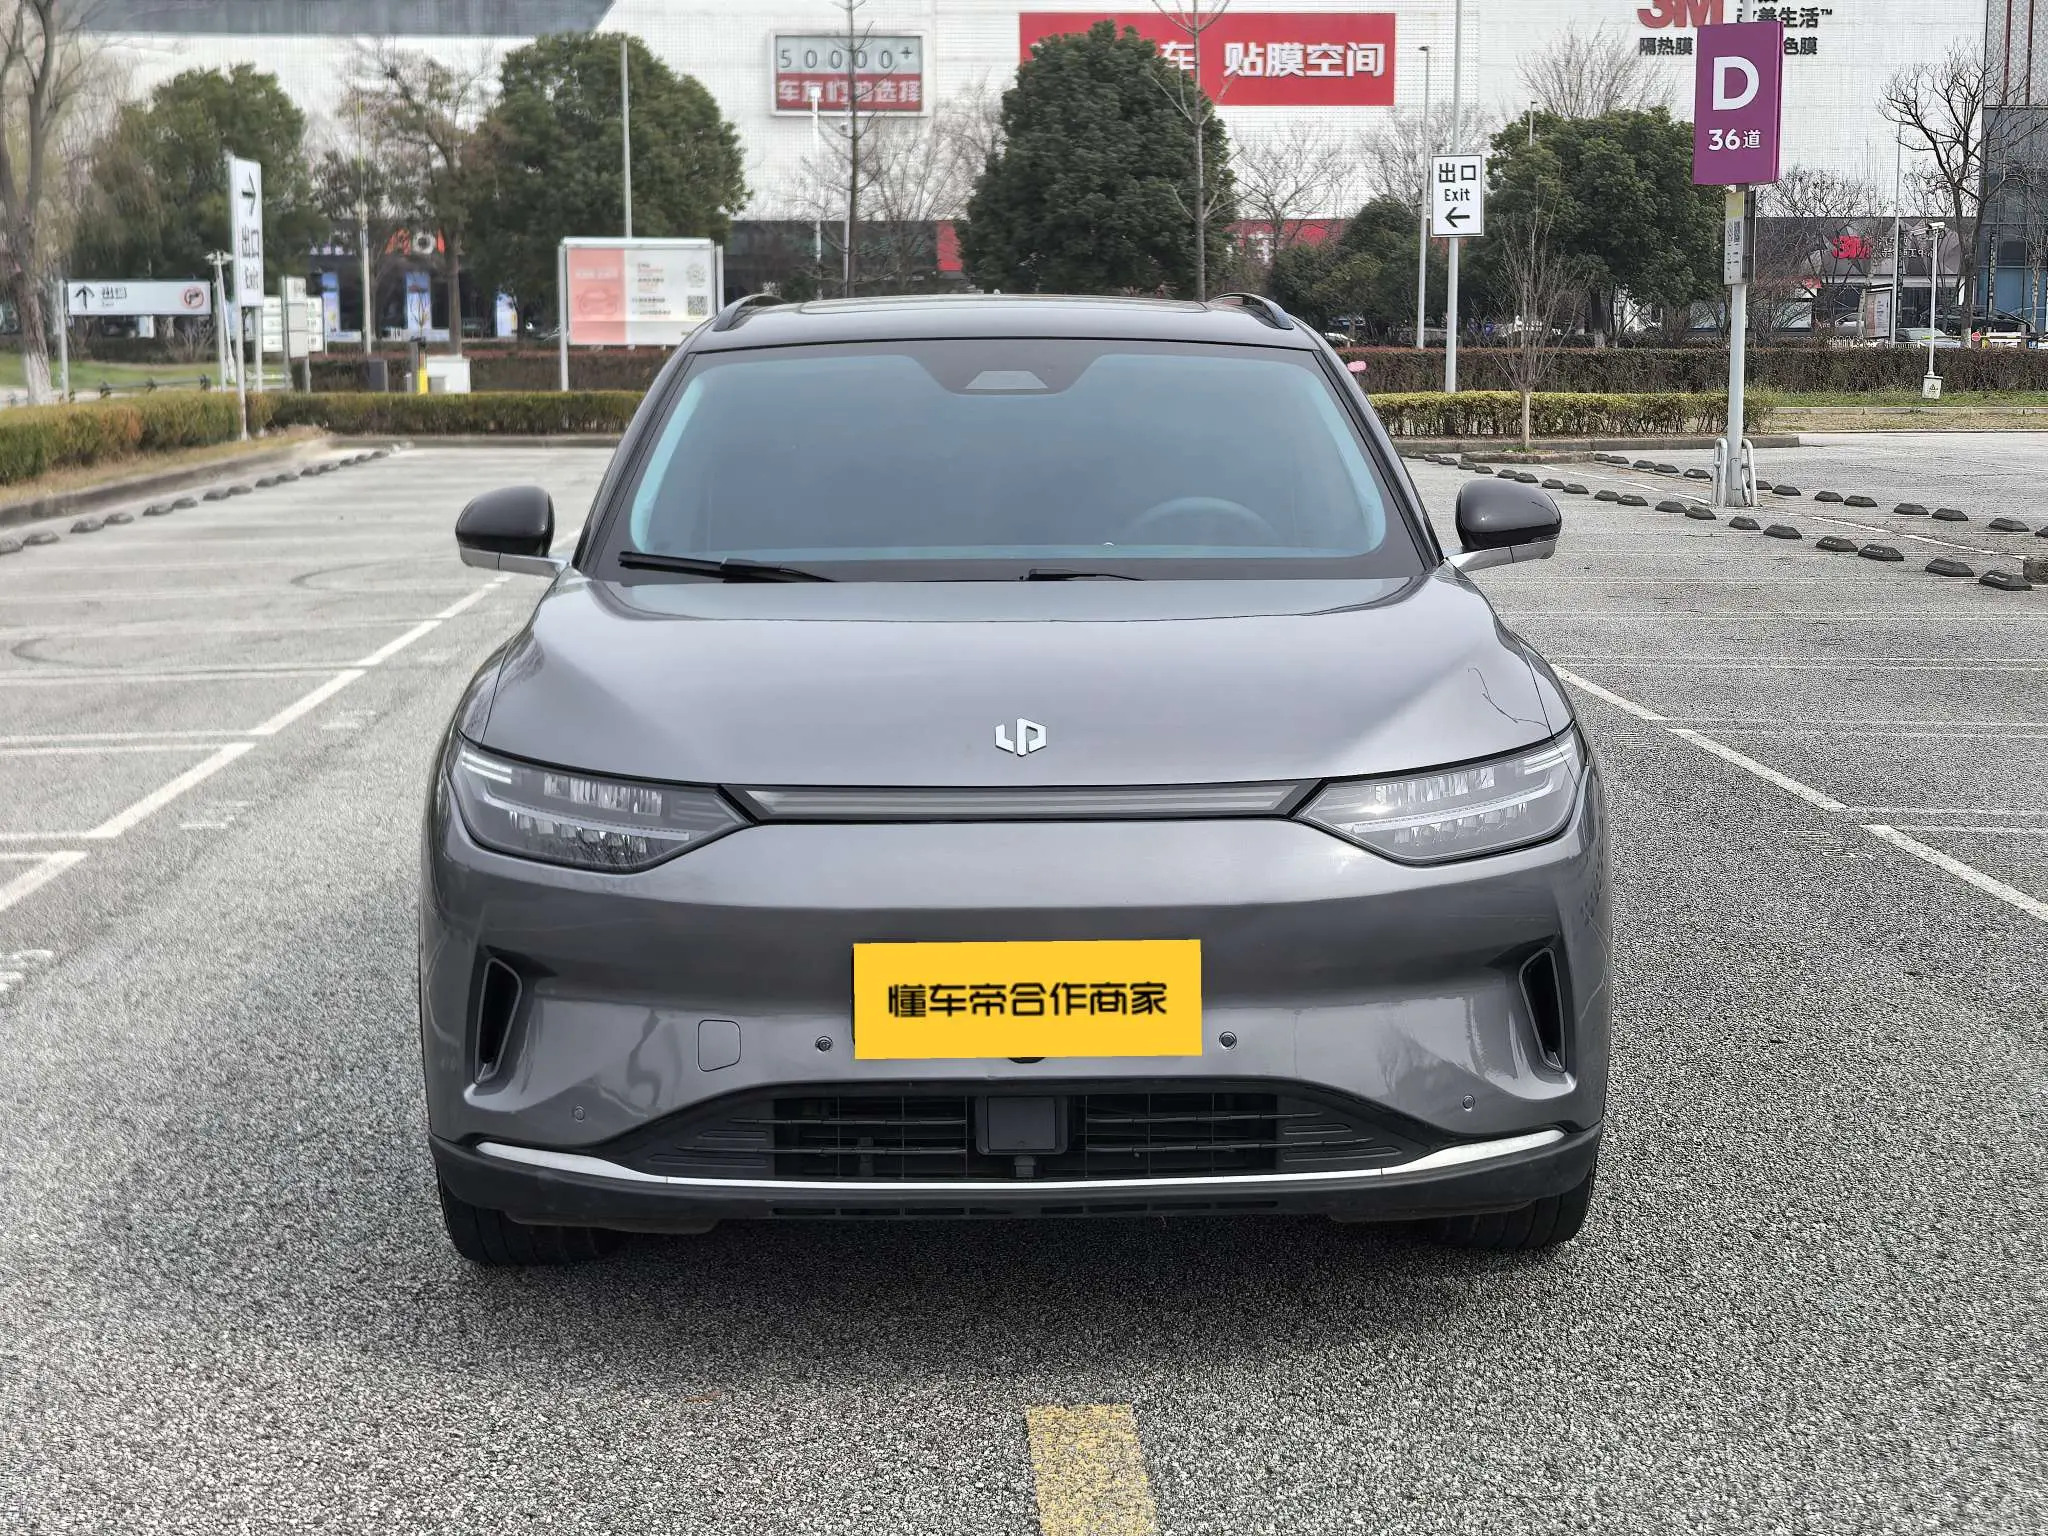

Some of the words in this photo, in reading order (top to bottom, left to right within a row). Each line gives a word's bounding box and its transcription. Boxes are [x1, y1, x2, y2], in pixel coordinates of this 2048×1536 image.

[1639, 37, 1693, 55] 隔热膜
[1224, 42, 1385, 77] 贴膜空间
[1713, 56, 1759, 110] D
[1708, 128, 1760, 150] 36道
[1439, 163, 1476, 183] 出口
[1444, 188, 1470, 201] Exit
[242, 224, 260, 259] 出口
